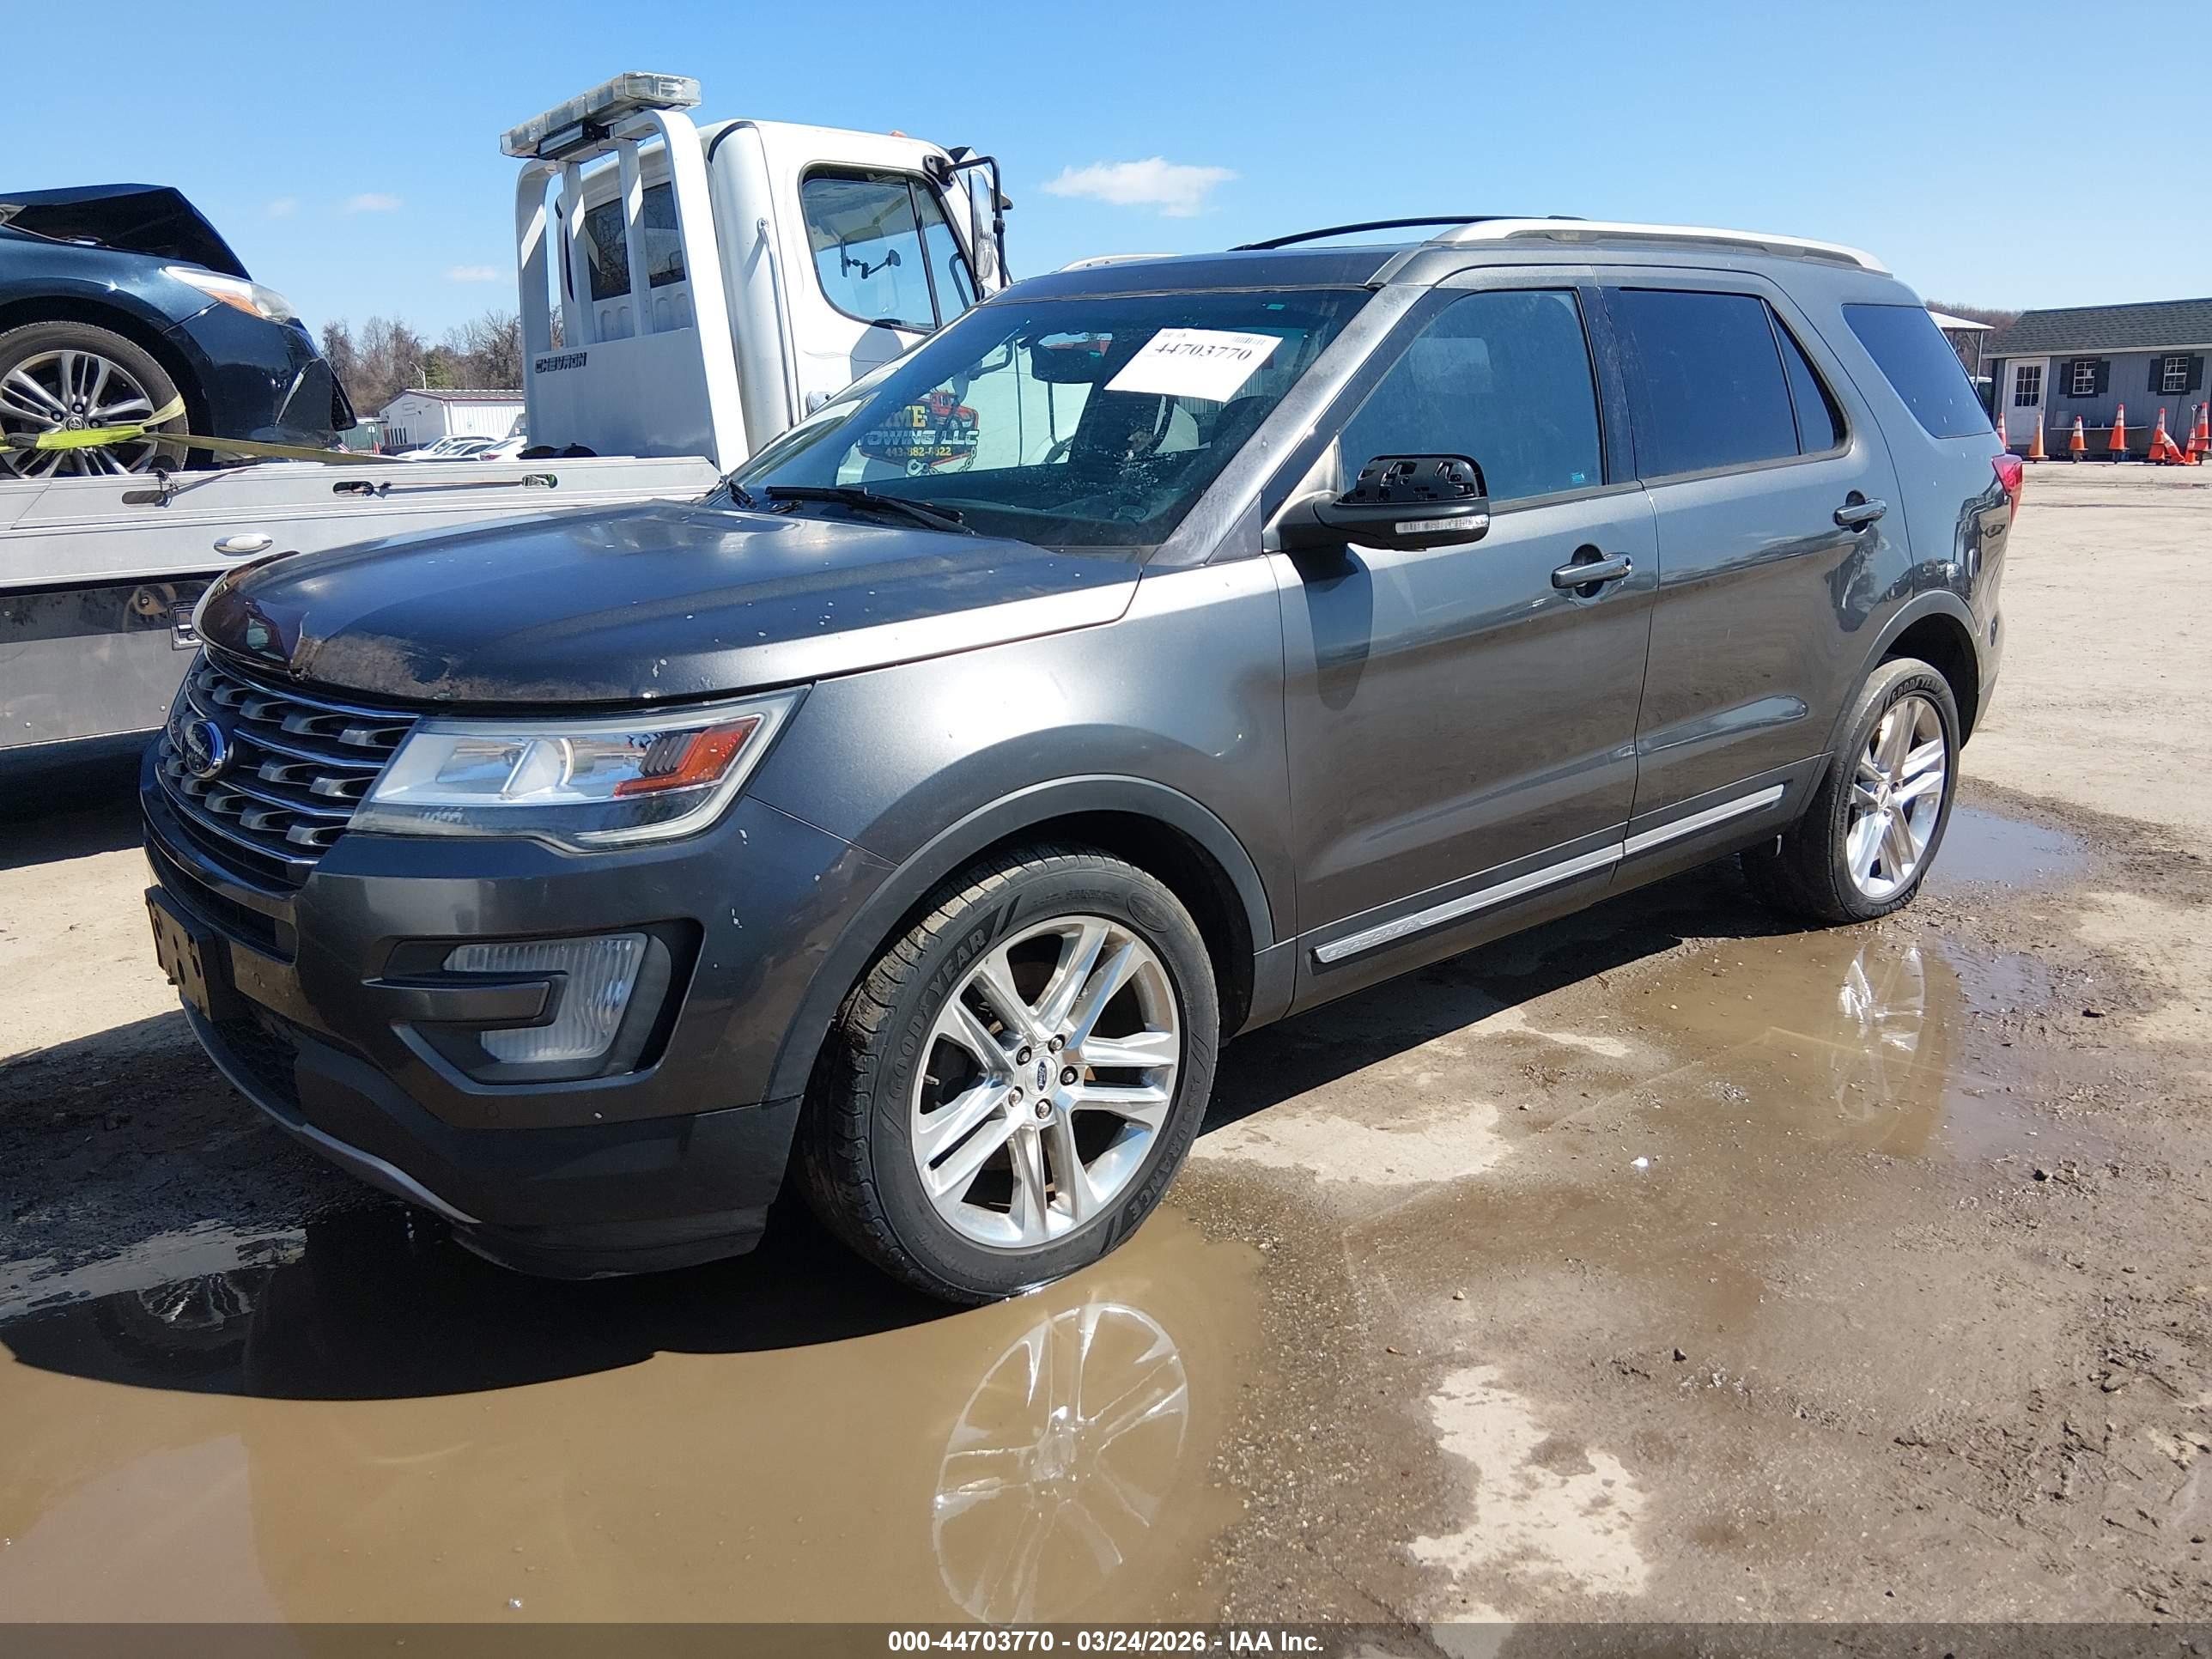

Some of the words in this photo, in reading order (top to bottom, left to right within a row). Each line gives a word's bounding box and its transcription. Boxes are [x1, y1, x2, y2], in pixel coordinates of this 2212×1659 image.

[1155, 343, 1253, 361] 44703770
[535, 351, 587, 374] CHEVRON
[941, 430, 979, 446] LLC
